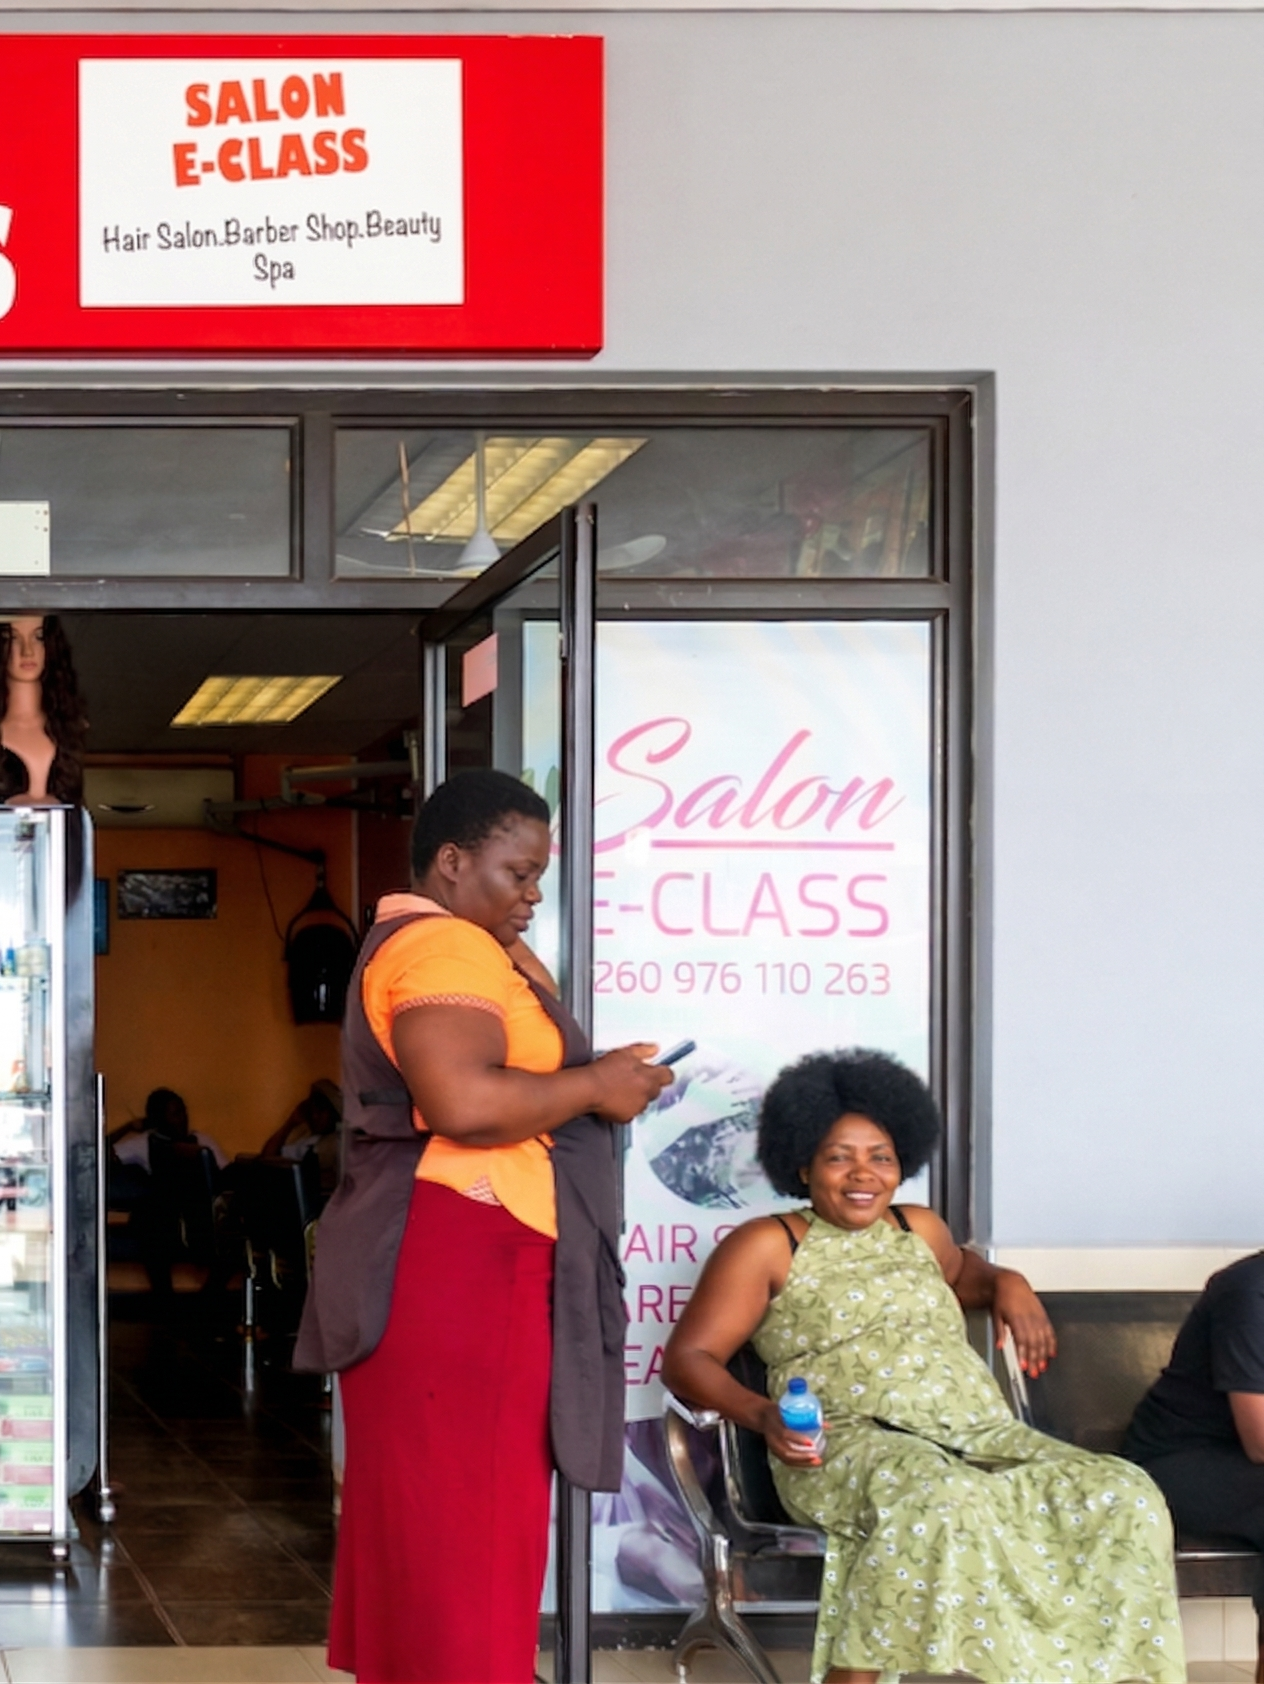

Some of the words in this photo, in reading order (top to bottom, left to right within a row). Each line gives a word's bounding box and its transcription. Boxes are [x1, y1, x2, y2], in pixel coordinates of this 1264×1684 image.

[184, 72, 345, 127] SALON
[172, 128, 369, 187] E-CLASS
[102, 225, 151, 253] Hair
[253, 252, 295, 290] Spa
[594, 716, 906, 855] Salon
[673, 961, 742, 994] 976
[754, 962, 811, 995] 110
[825, 962, 891, 995] 263
[623, 1223, 698, 1264] AIR
